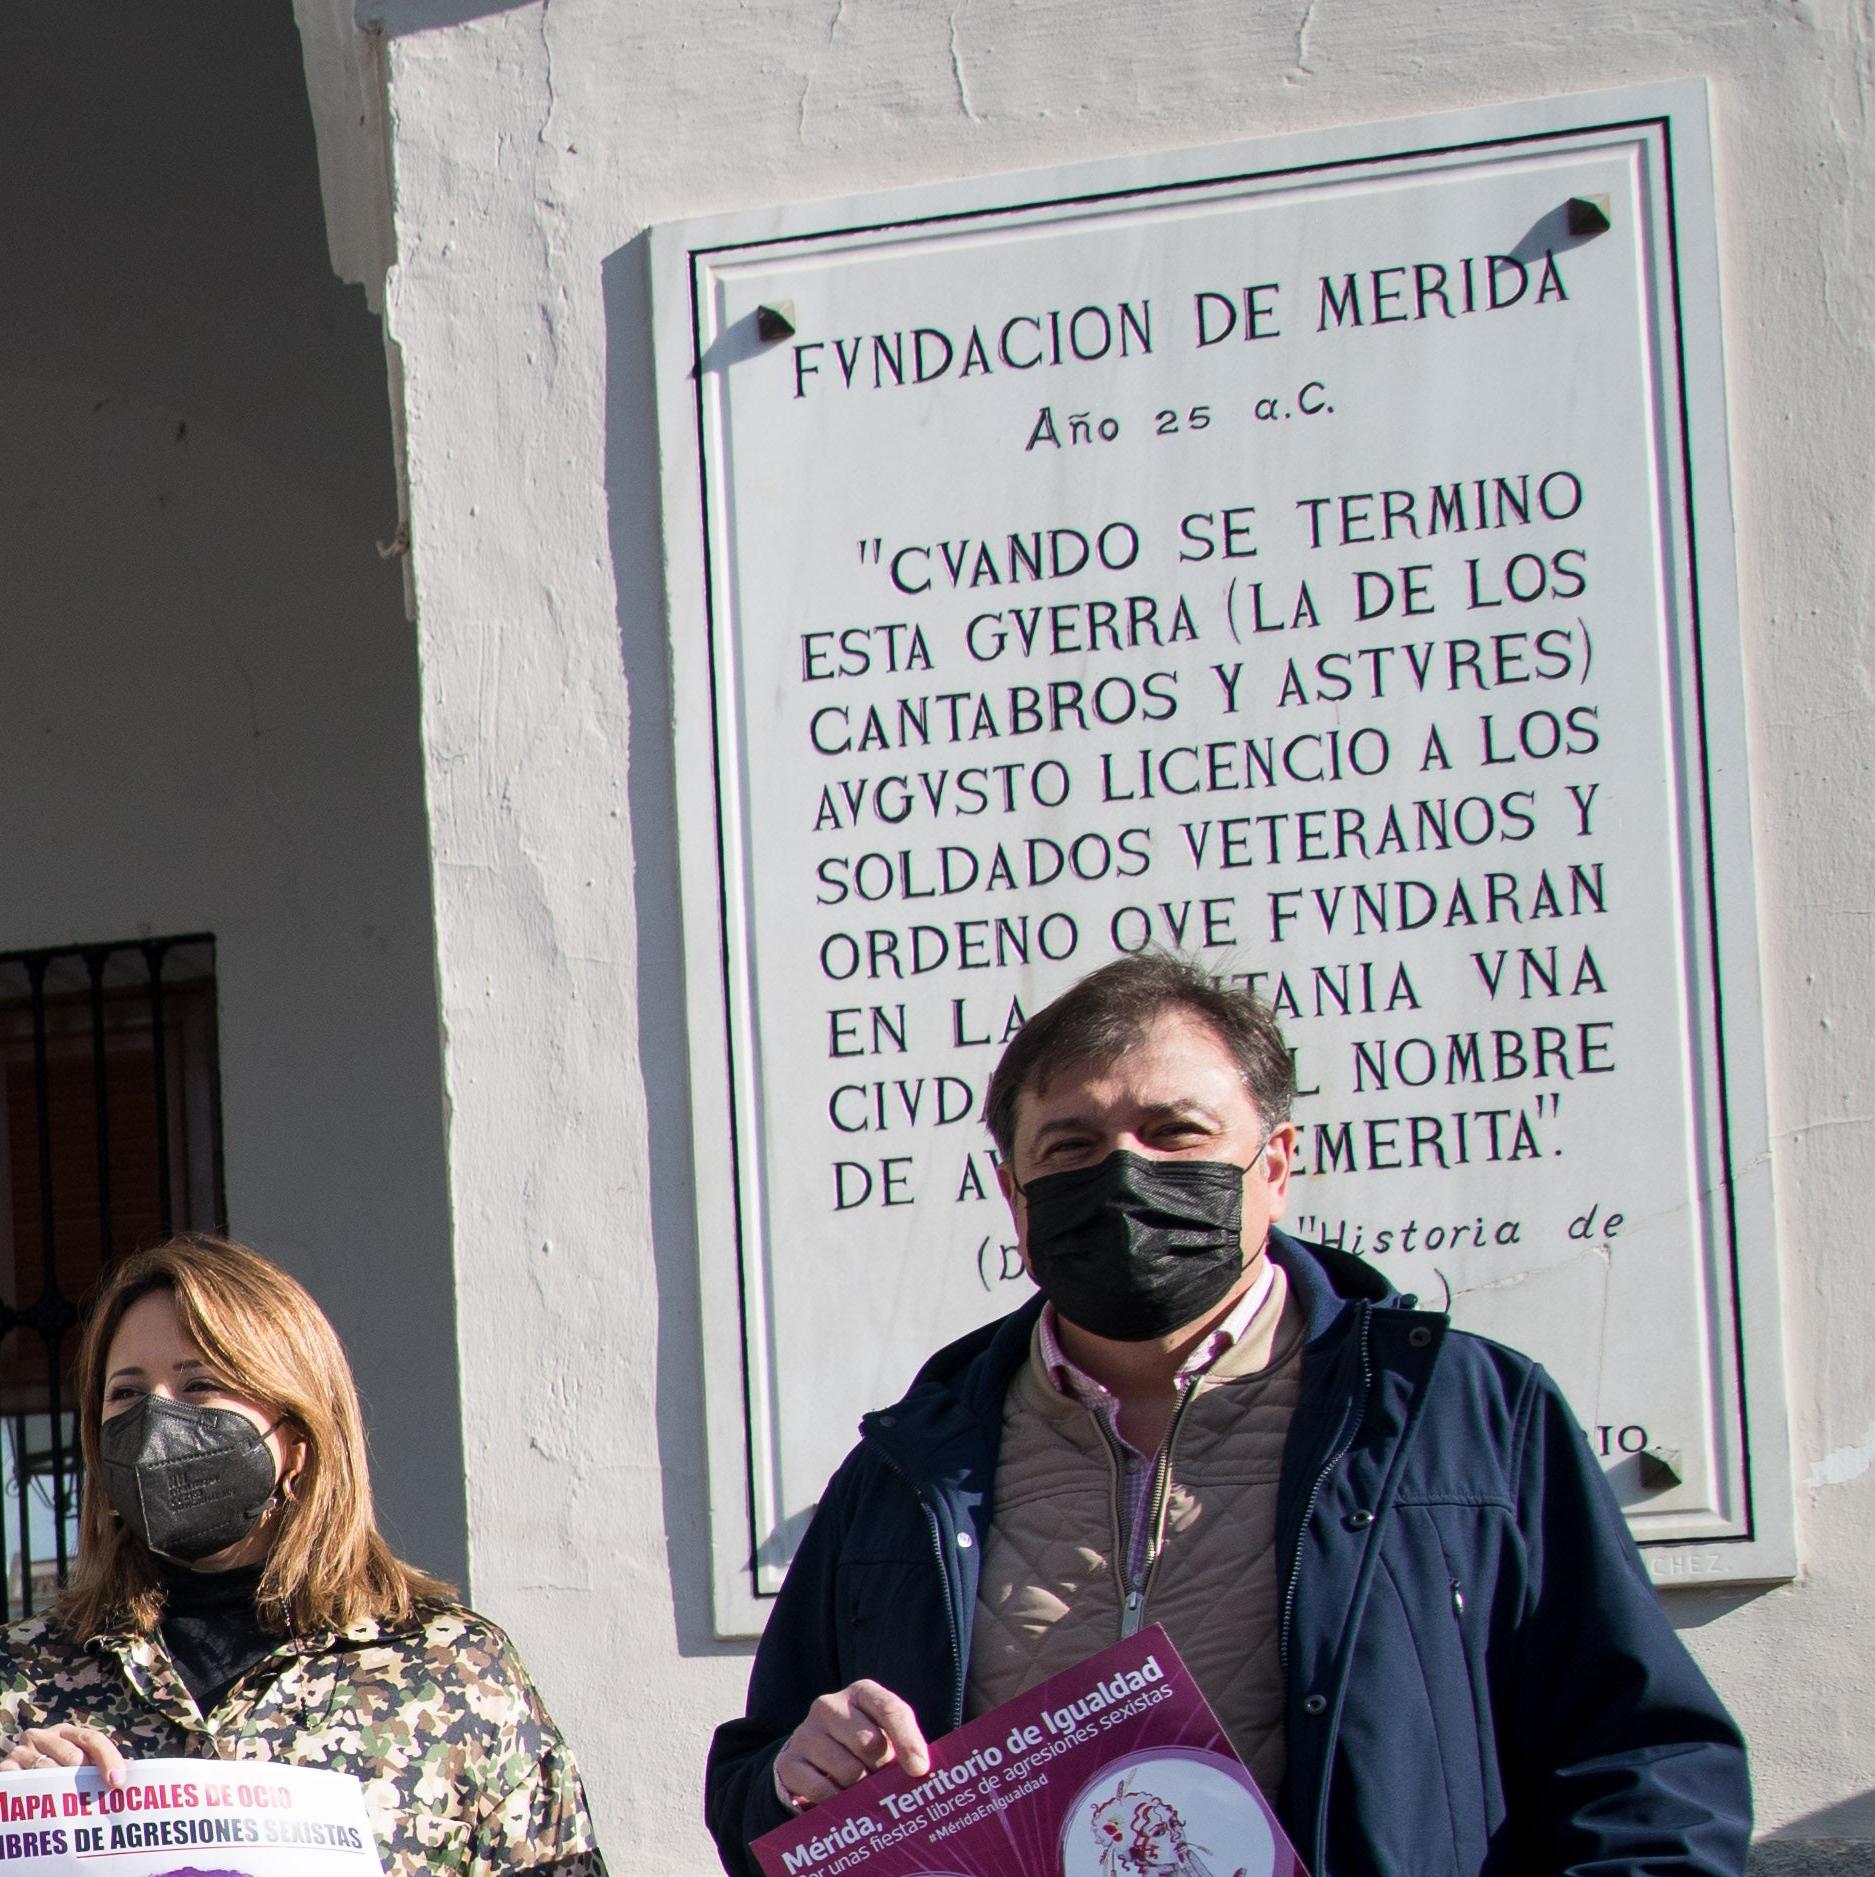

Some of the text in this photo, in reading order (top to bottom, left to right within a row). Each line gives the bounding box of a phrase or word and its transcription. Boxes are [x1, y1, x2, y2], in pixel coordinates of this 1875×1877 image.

[795, 246, 1568, 397] FVNDACION DE MERIDA
[1026, 407, 1119, 451] Año
[1156, 406, 1210, 435] 25
[1180, 507, 1257, 562] SE
[1296, 471, 1582, 548] TERMINO
[801, 550, 1586, 681] ESTA GVERRA (LA DE LOS
[811, 618, 1591, 755] CANTABROS Y ASTVRES)
[814, 706, 1599, 831] AVGVSTO LICENCIO A LOS
[817, 784, 1599, 904] SOLDADOS VETERANOS Y
[821, 913, 1077, 979] ORDENO
[1268, 863, 1606, 942] FVNDARAN
[828, 1004, 907, 1058] EN
[1470, 945, 1607, 1000] VNA
[830, 1076, 989, 1133] CIVD
[1352, 1022, 1614, 1092] NOMBRE
[833, 1157, 914, 1211] DE
[1568, 1204, 1623, 1248] de
[1651, 1552, 1732, 1577] CHEZ.
[63, 1791, 93, 1817] DE
[97, 1784, 199, 1814] LOCALES
[782, 1656, 1165, 1876] Mérida, Territorio de Igualdad
[828, 1846, 870, 1875] unas
[870, 1815, 927, 1852] fiestas
[926, 1789, 975, 1821] libres
[978, 1776, 1001, 1794] de
[1003, 1723, 1098, 1781] agresiones
[1100, 1684, 1173, 1729] sexistas
[74, 1827, 104, 1852] DE
[111, 1820, 258, 1849] AGRESIONES
